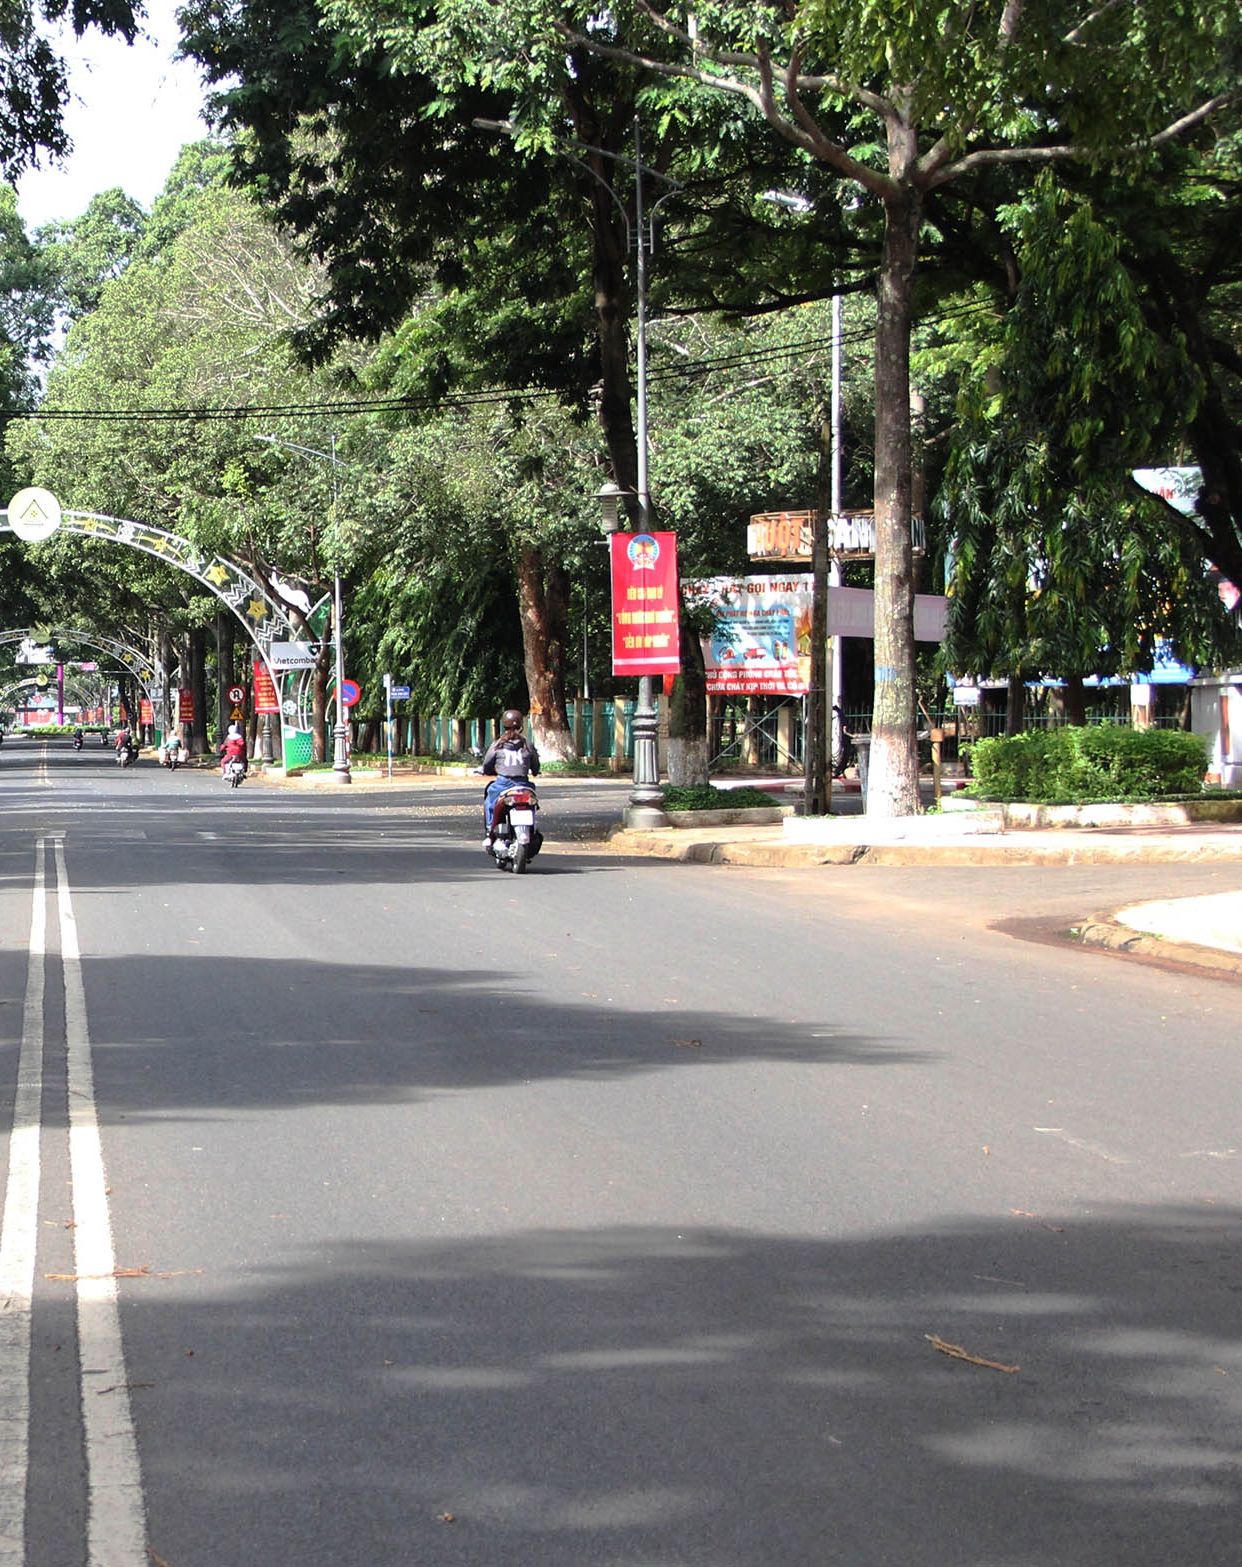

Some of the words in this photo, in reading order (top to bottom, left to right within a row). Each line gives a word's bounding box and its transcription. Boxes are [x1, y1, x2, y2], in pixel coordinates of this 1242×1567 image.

[746, 583, 766, 595] GỌI
[769, 581, 799, 592] NGAY
[273, 656, 318, 665] Vietcomba
